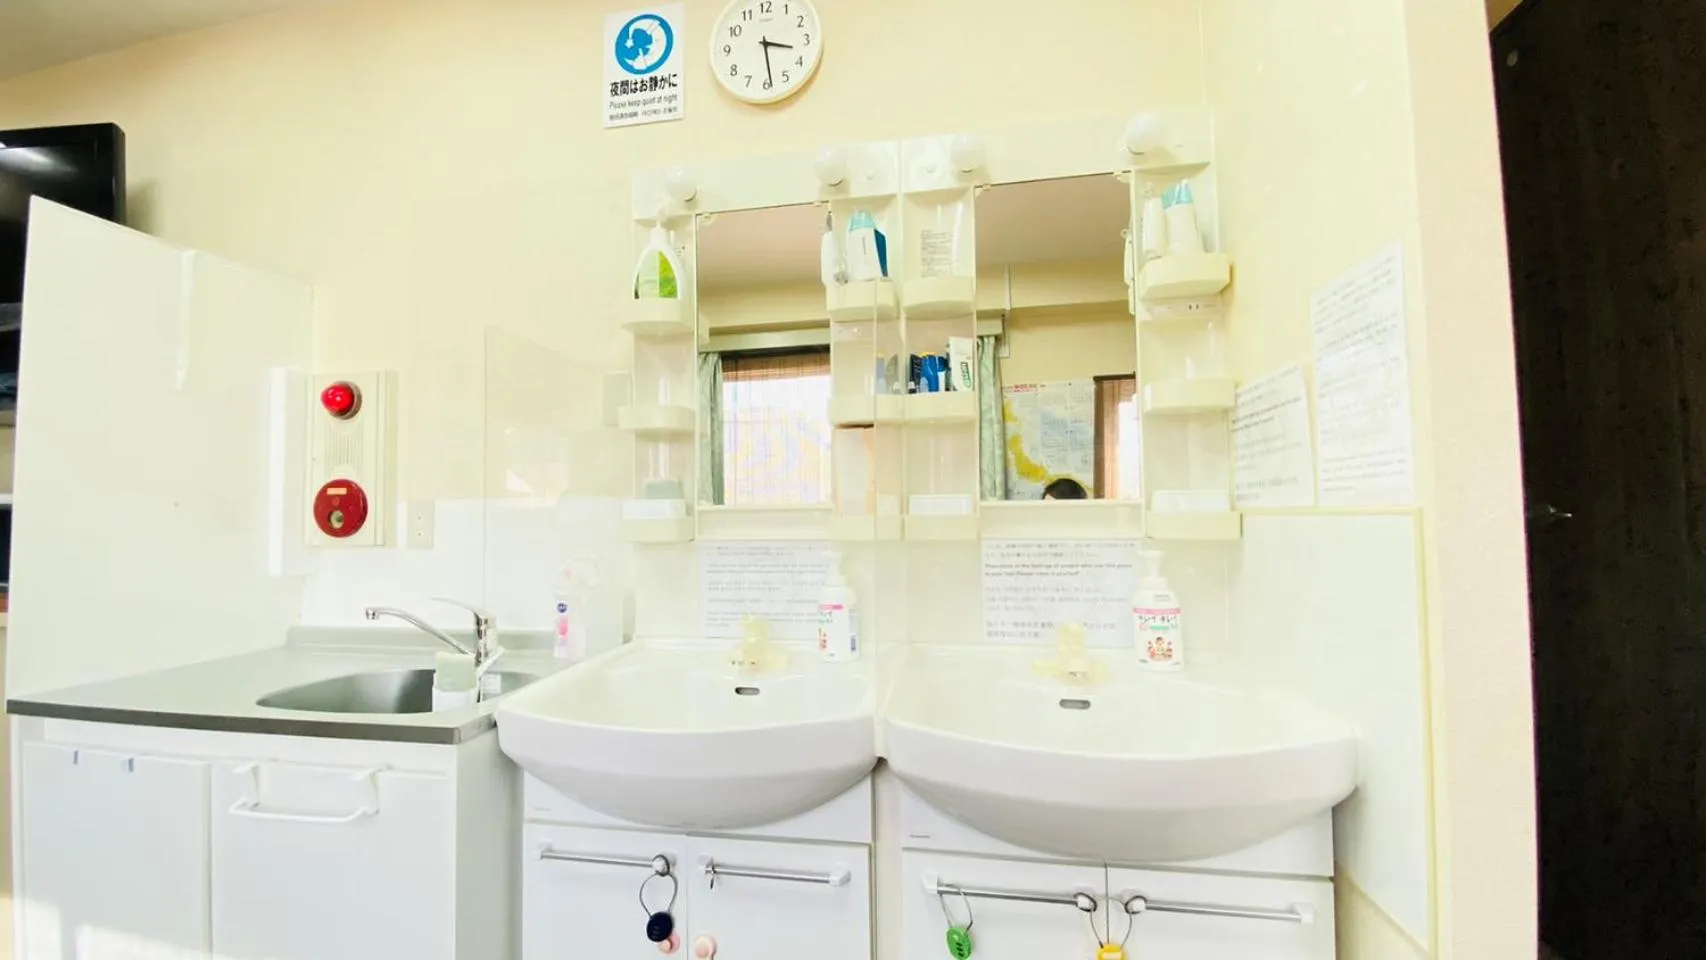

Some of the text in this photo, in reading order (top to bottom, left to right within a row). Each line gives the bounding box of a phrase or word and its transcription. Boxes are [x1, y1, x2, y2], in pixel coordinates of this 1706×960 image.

[760, 1, 773, 14] 12
[784, 4, 789, 15] 1
[742, 9, 753, 21] 11
[797, 16, 805, 28] 2
[729, 25, 742, 38] 10
[804, 33, 811, 46] 3
[723, 45, 731, 57] 9
[795, 56, 804, 67] 4
[730, 64, 738, 77] 8
[782, 70, 790, 83] 5
[609, 73, 678, 97] 夜間はお静かに
[745, 75, 753, 88] 7
[762, 79, 770, 90] 6
[609, 101, 627, 110] Please
[627, 99, 641, 108] keep
[642, 97, 656, 106] quiet
[663, 94, 678, 104] night
